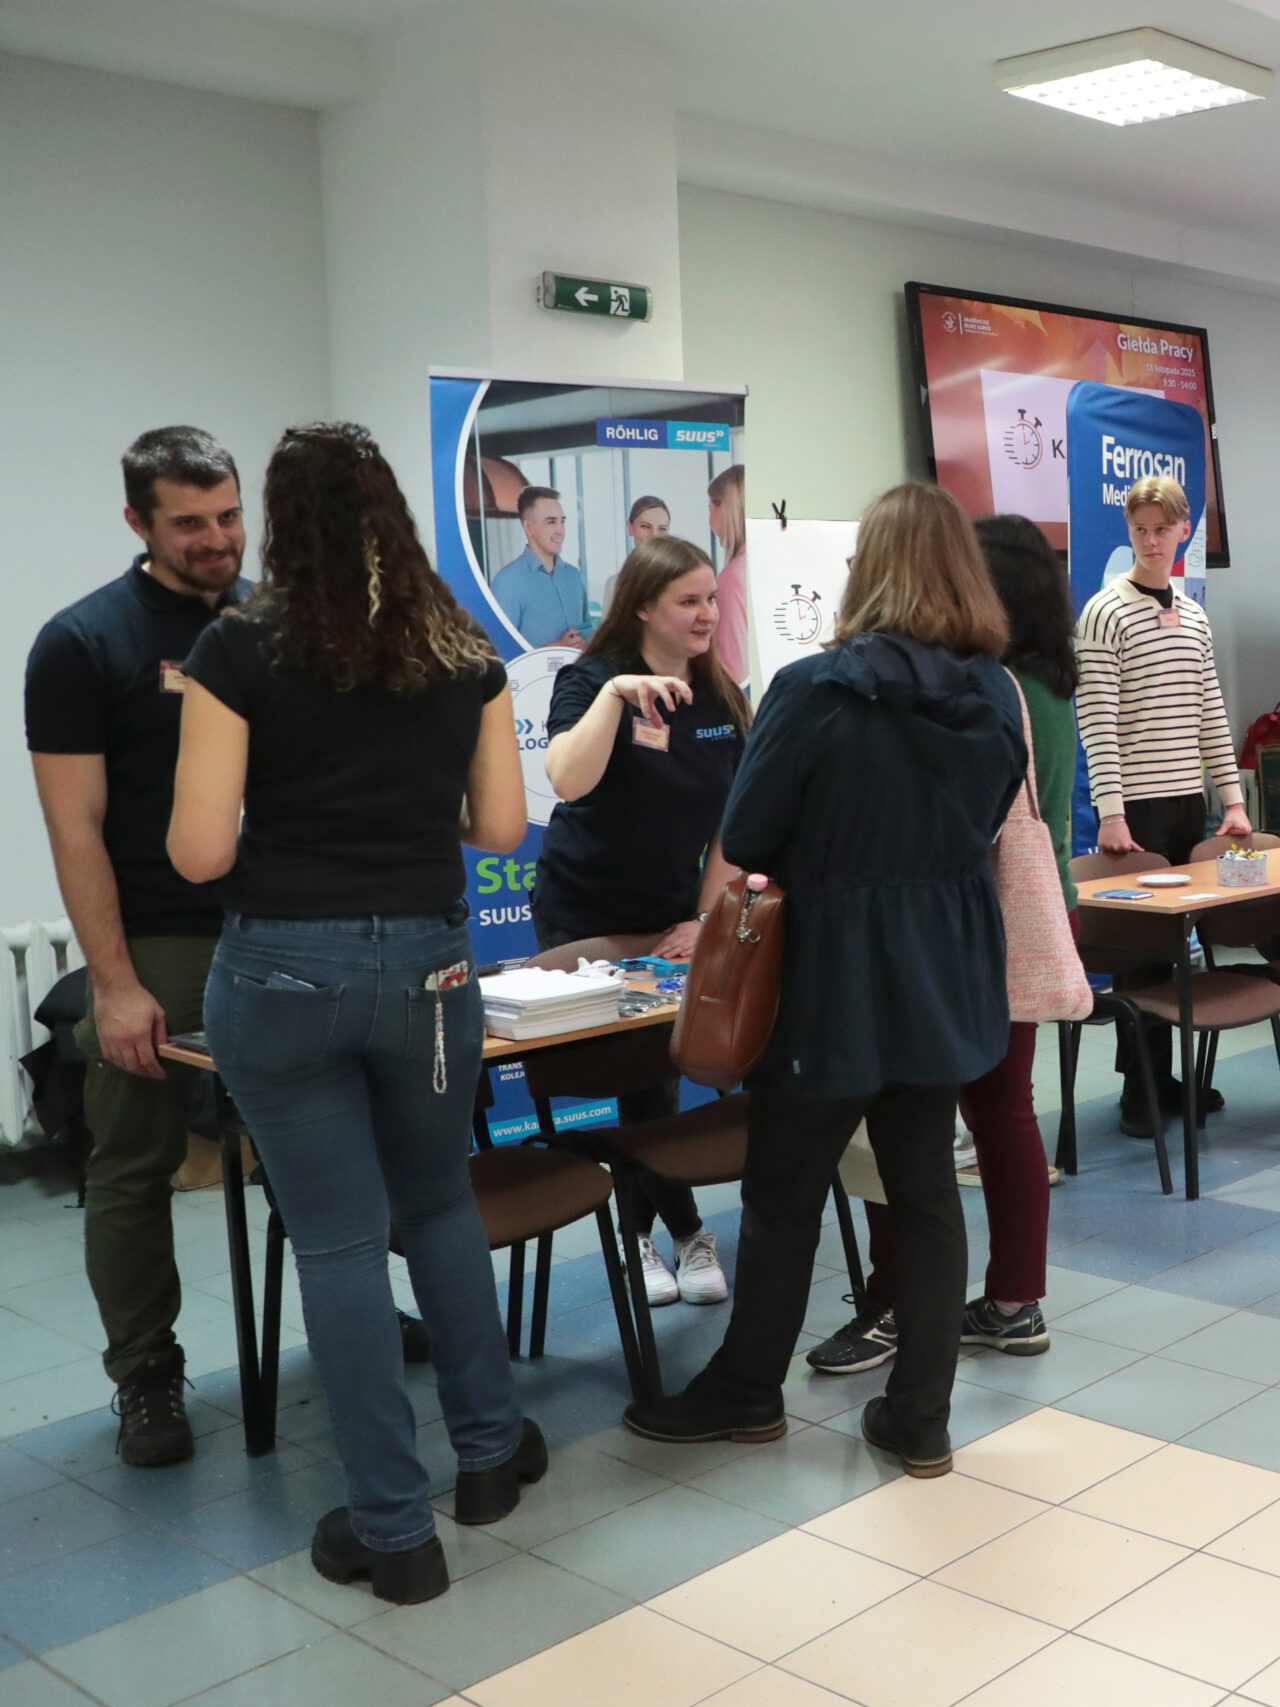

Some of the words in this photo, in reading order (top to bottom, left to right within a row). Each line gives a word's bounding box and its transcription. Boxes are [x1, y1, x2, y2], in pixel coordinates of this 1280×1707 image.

[1117, 333, 1157, 354] Giełda
[1160, 340, 1193, 362] Pracy
[606, 425, 658, 440] RÖHLIG
[1102, 435, 1185, 487] Ferrosan
[1103, 483, 1130, 507] Medi
[517, 737, 549, 751] LOG
[476, 857, 537, 894] Sta
[479, 904, 532, 926] SUUS
[500, 1071, 525, 1081] KOLEJ
